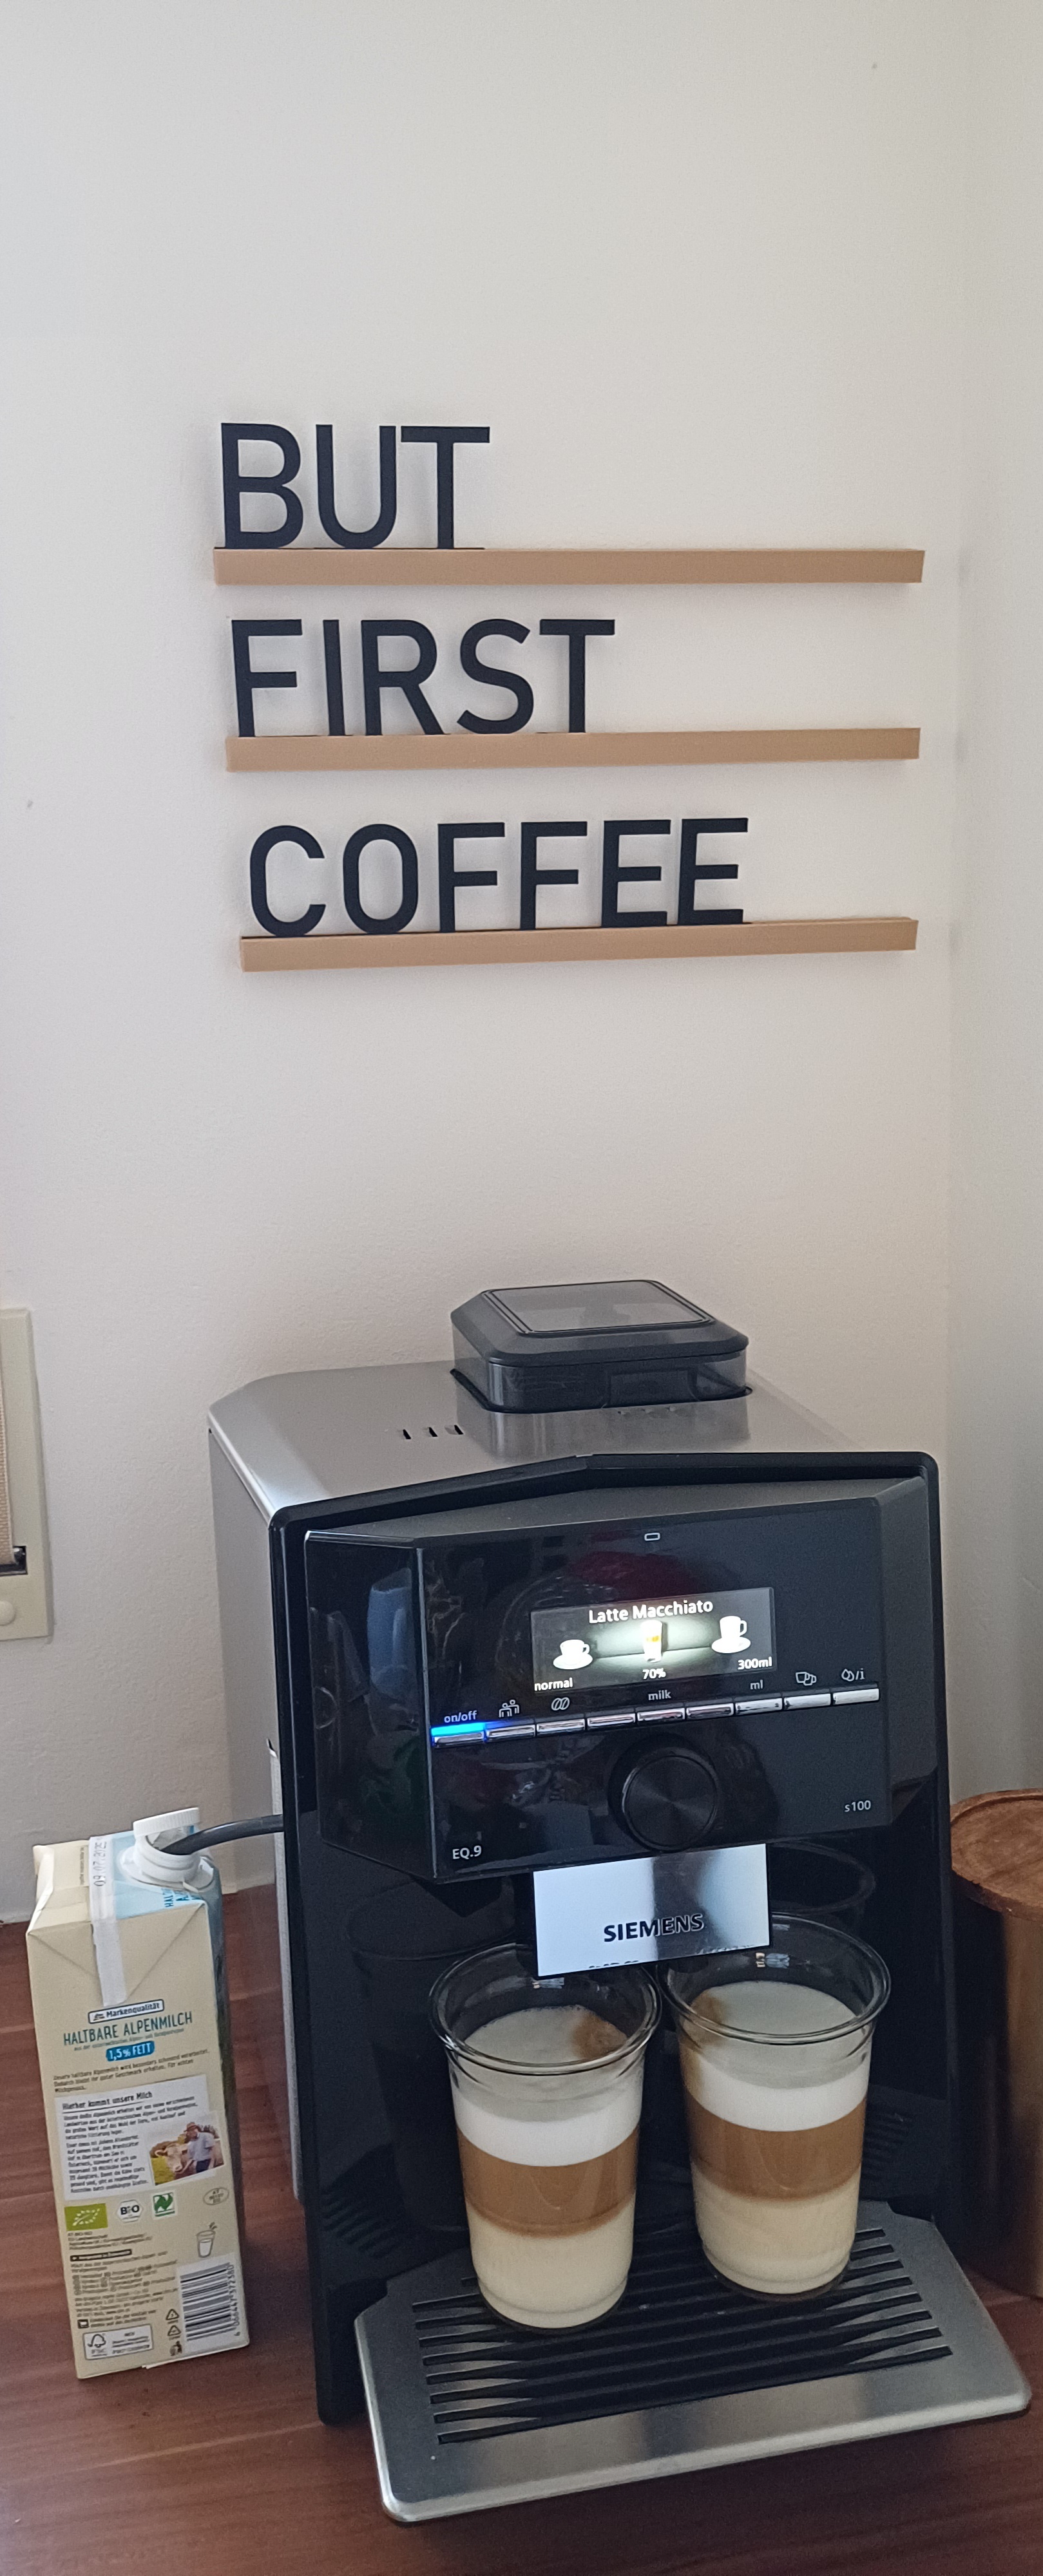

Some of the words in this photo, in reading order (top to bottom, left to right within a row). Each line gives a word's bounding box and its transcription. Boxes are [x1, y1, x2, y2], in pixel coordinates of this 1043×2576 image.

[221, 422, 490, 549] BUT
[231, 619, 615, 737] FIRST
[249, 818, 749, 937] COFFEE
[589, 1606, 629, 1624] Latte
[633, 1598, 713, 1619] Macchiato
[738, 1656, 772, 1670] 300ml
[642, 1667, 666, 1679] 70%
[534, 1677, 573, 1691] normal
[751, 1680, 763, 1690] ml
[648, 1689, 672, 1700] milk
[444, 1709, 477, 1722] on/off
[845, 1800, 872, 1812] s100
[452, 1846, 482, 1860] EQ.9
[604, 1913, 704, 1942] SIEMENS
[106, 2003, 160, 2018] Markenqualität
[64, 2025, 119, 2045] HALTBARE
[124, 2011, 192, 2036] ALPENMILCH
[110, 2049, 131, 2060] 1,5%
[133, 2043, 151, 2055] FETT
[112, 2095, 134, 2104] unsere
[137, 2091, 153, 2099] Milch
